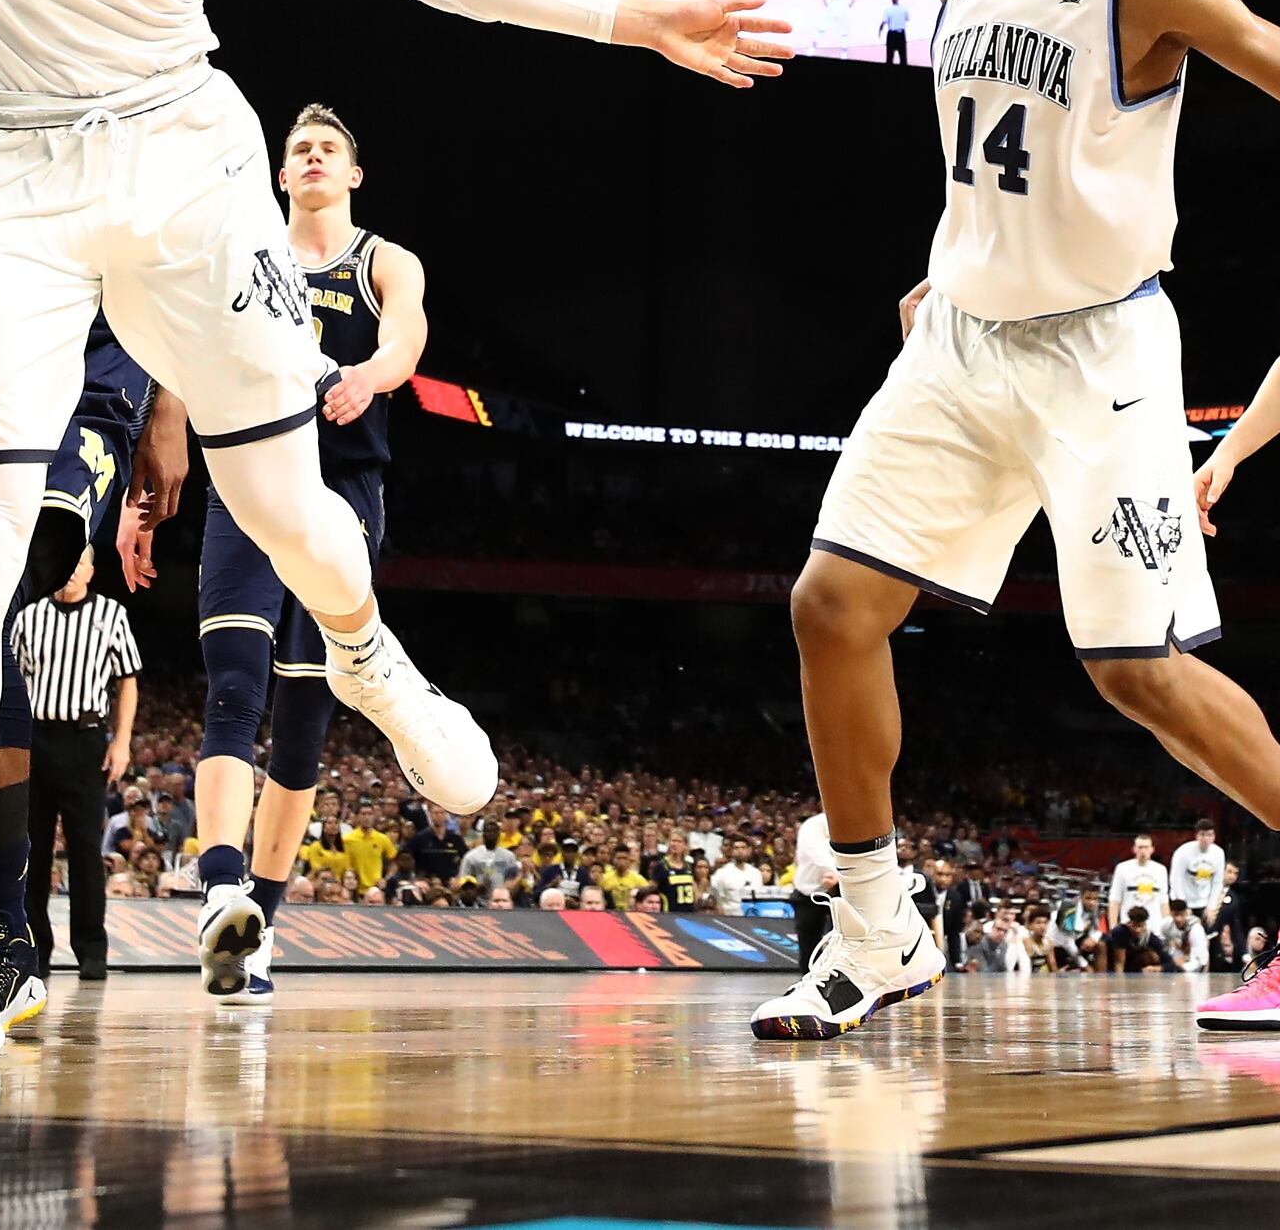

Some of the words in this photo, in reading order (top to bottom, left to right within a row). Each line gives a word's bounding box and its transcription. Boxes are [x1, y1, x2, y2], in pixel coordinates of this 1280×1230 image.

[937, 22, 1076, 111] VILLANOVA
[952, 95, 1032, 196] 14
[565, 422, 666, 442] WELCOME
[669, 428, 697, 444] TO
[700, 429, 742, 446] THE
[745, 432, 795, 449] 2018
[676, 886, 694, 905] 13
